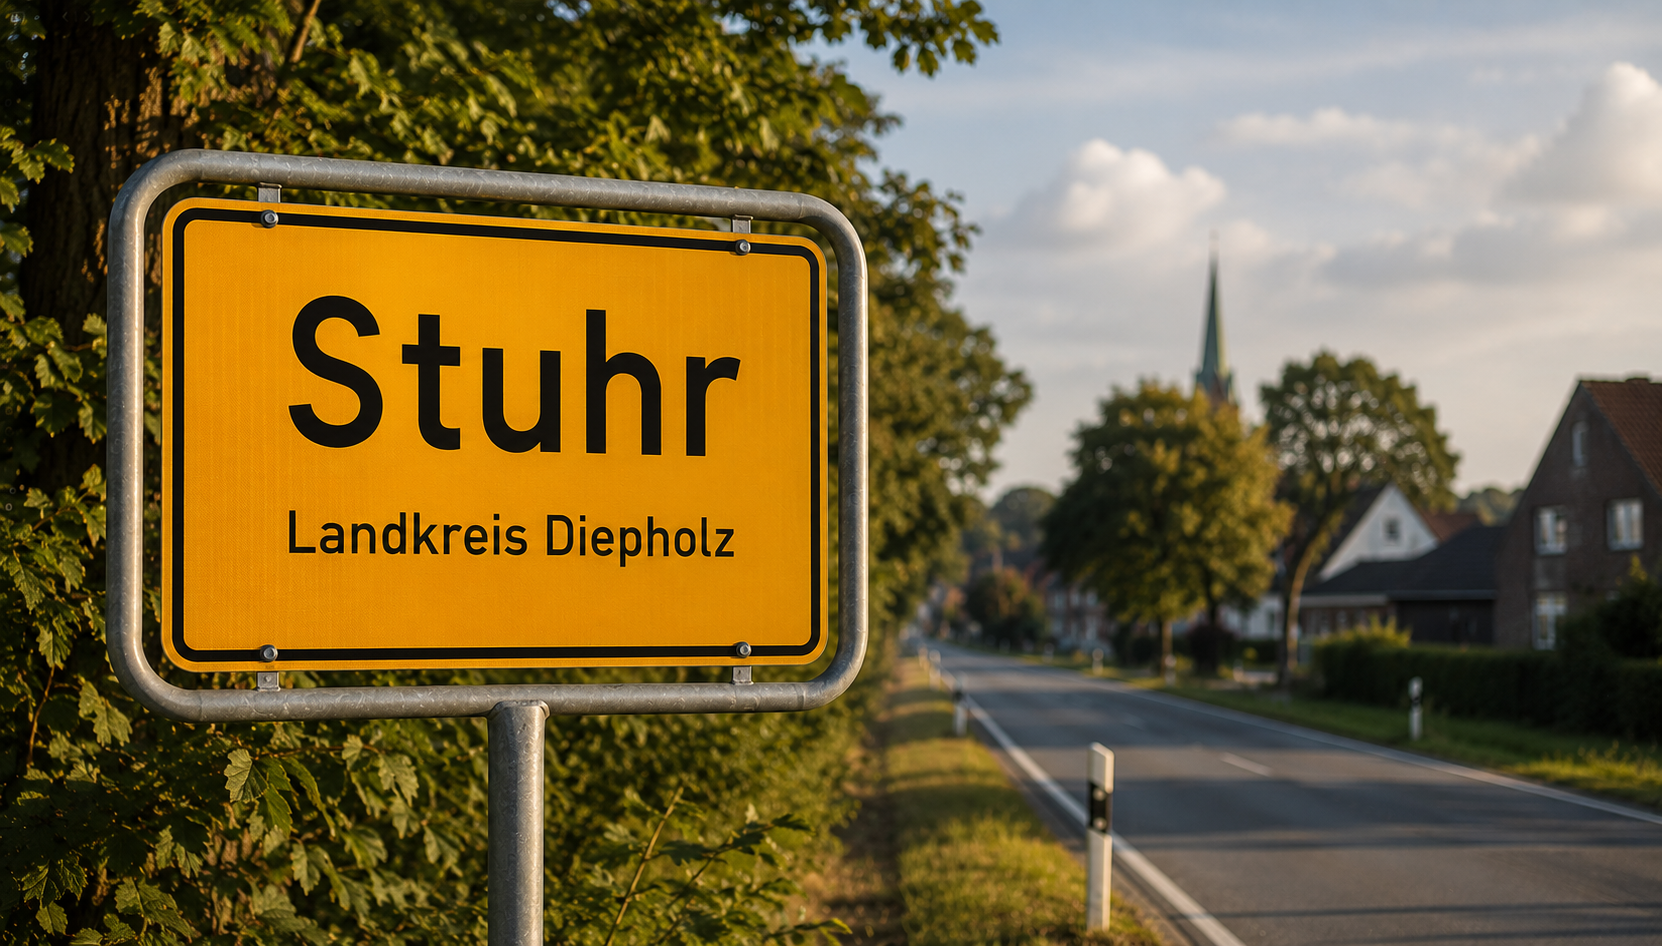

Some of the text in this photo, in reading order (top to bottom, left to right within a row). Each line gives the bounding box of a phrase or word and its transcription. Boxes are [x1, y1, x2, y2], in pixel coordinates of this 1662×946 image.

[289, 295, 740, 456] Stuhr
[289, 510, 735, 567] Landkreis Diepholz
